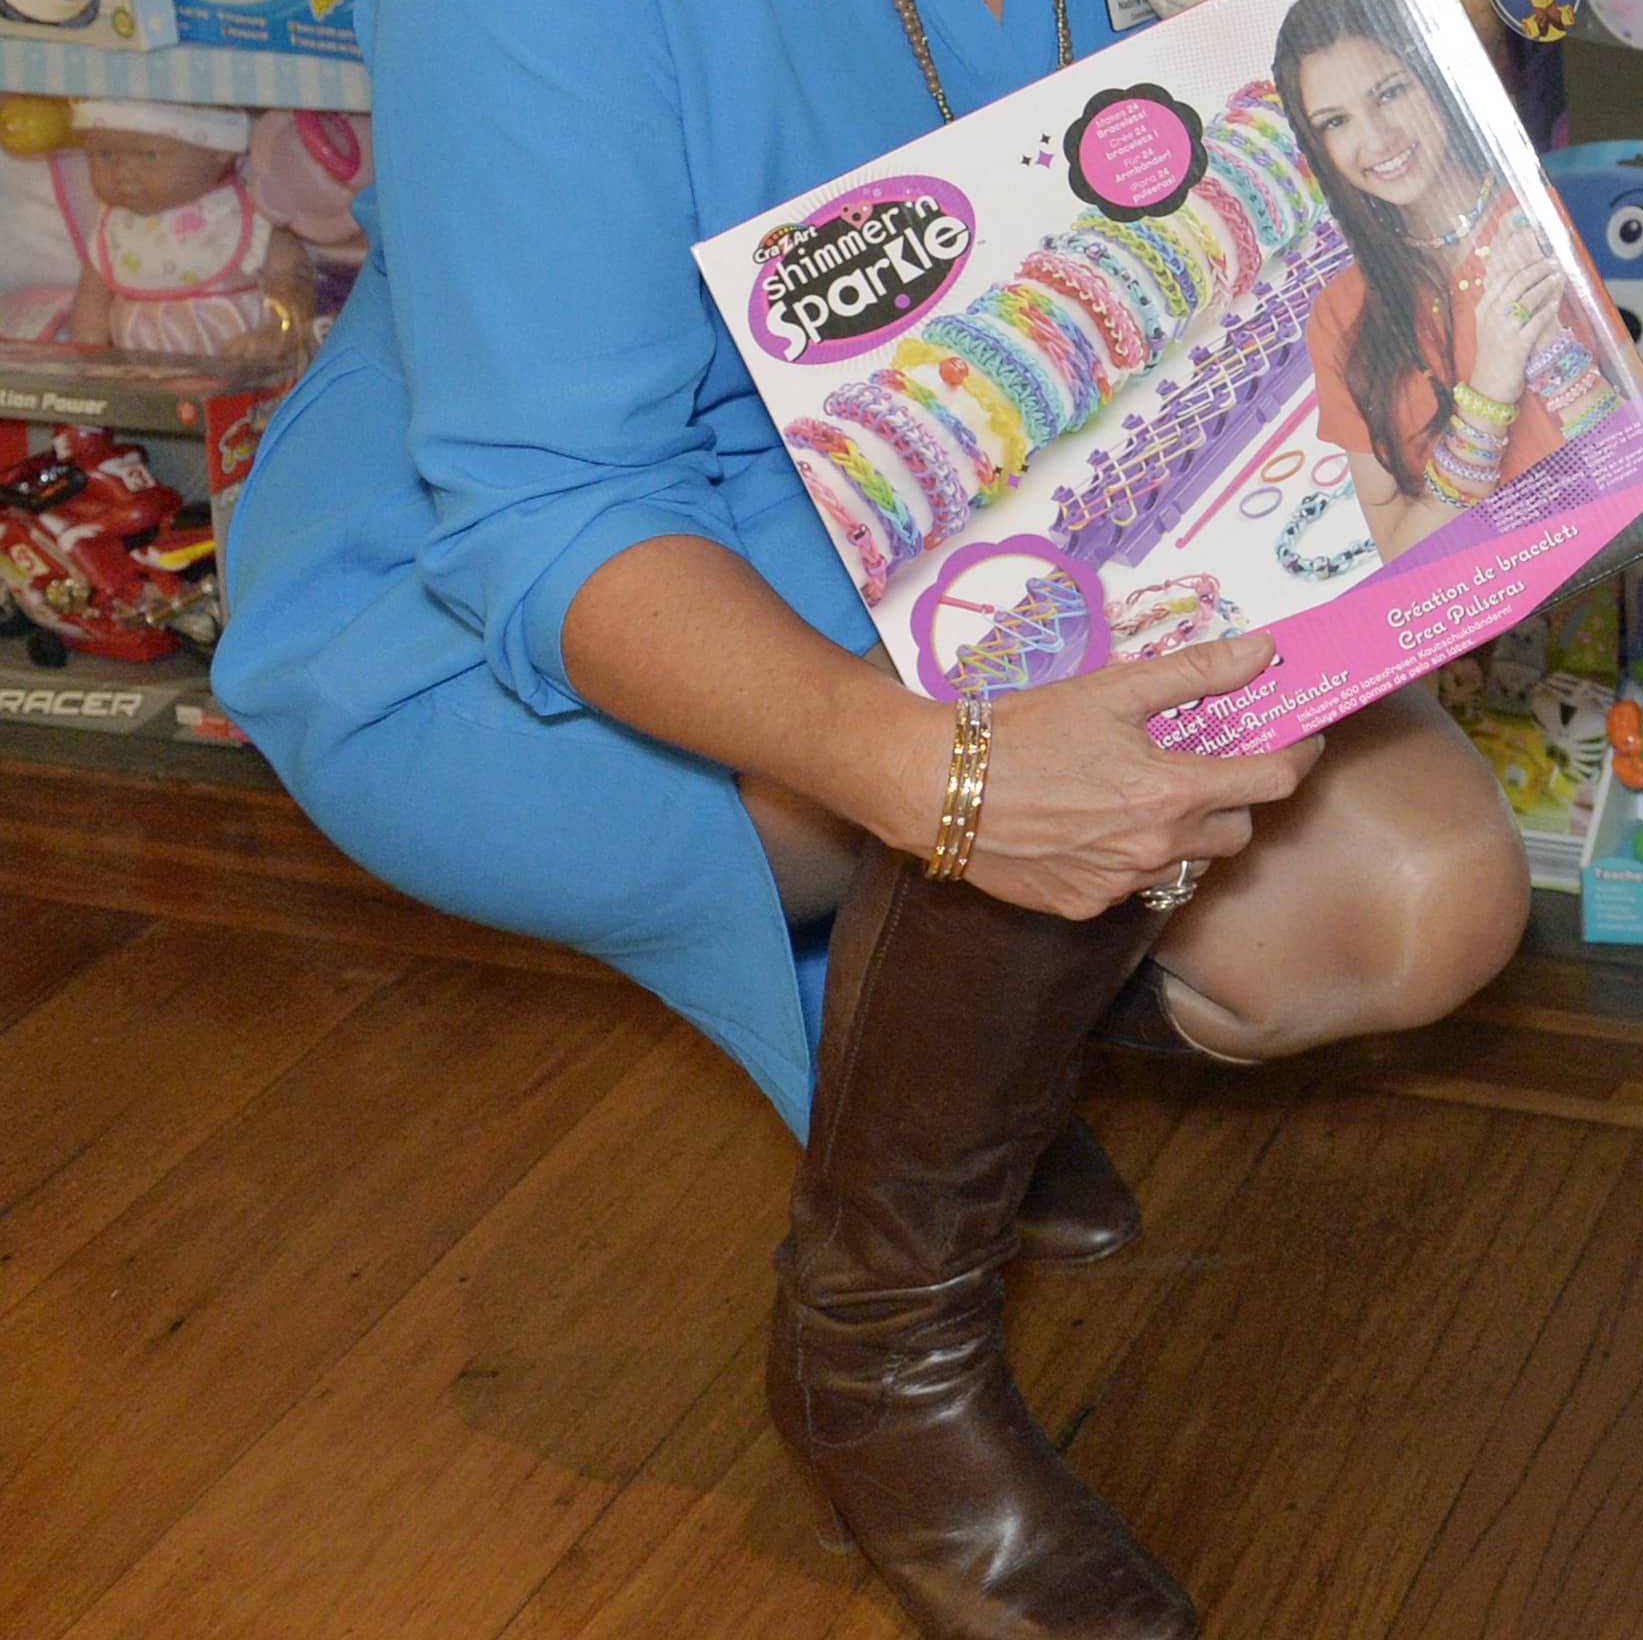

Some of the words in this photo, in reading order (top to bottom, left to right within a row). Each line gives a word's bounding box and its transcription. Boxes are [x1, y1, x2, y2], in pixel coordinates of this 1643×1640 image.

[762, 206, 900, 301] shimmer
[41, 391, 108, 415] Power
[1387, 579, 1470, 629] Création
[1472, 565, 1497, 588] de
[1499, 521, 1581, 580] bracelets
[1398, 620, 1448, 653] Crea
[1446, 578, 1527, 627] Pulseras
[1206, 677, 1279, 721] Maker
[1337, 697, 1359, 716] 600
[1358, 680, 1395, 708] gomas
[1394, 672, 1410, 688] de
[1408, 661, 1432, 685] pelo
[1430, 655, 1448, 672] sin
[1340, 683, 1361, 703] 600
